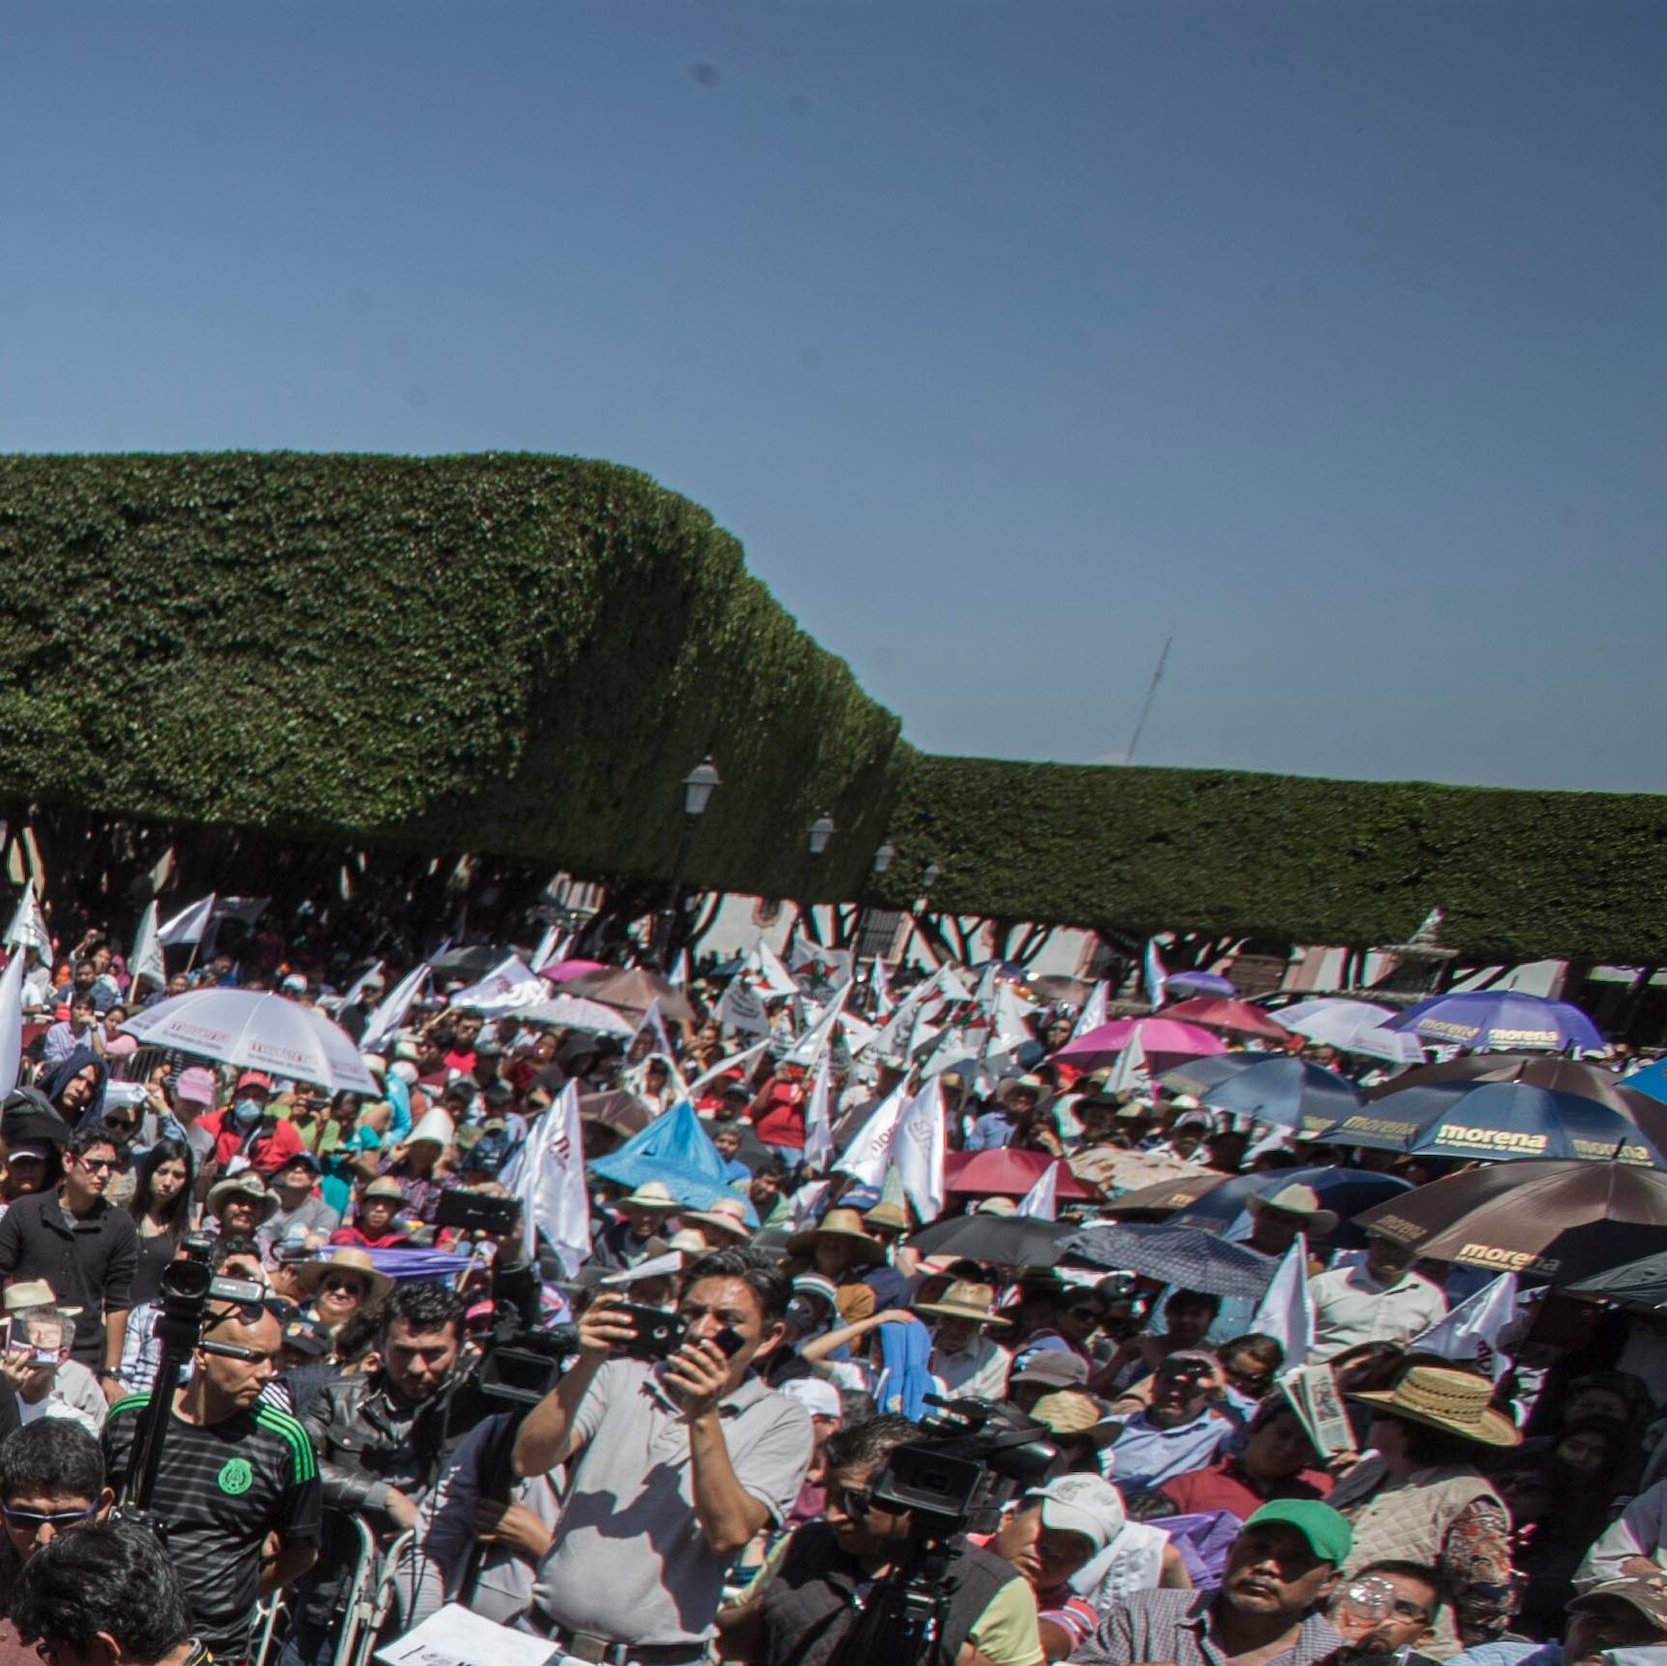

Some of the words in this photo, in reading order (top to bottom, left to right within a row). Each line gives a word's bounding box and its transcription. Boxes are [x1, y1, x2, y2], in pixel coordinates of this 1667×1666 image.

[1488, 1028, 1559, 1043] morena
[1439, 1123, 1548, 1149] morena
[1460, 1242, 1563, 1272] morena
